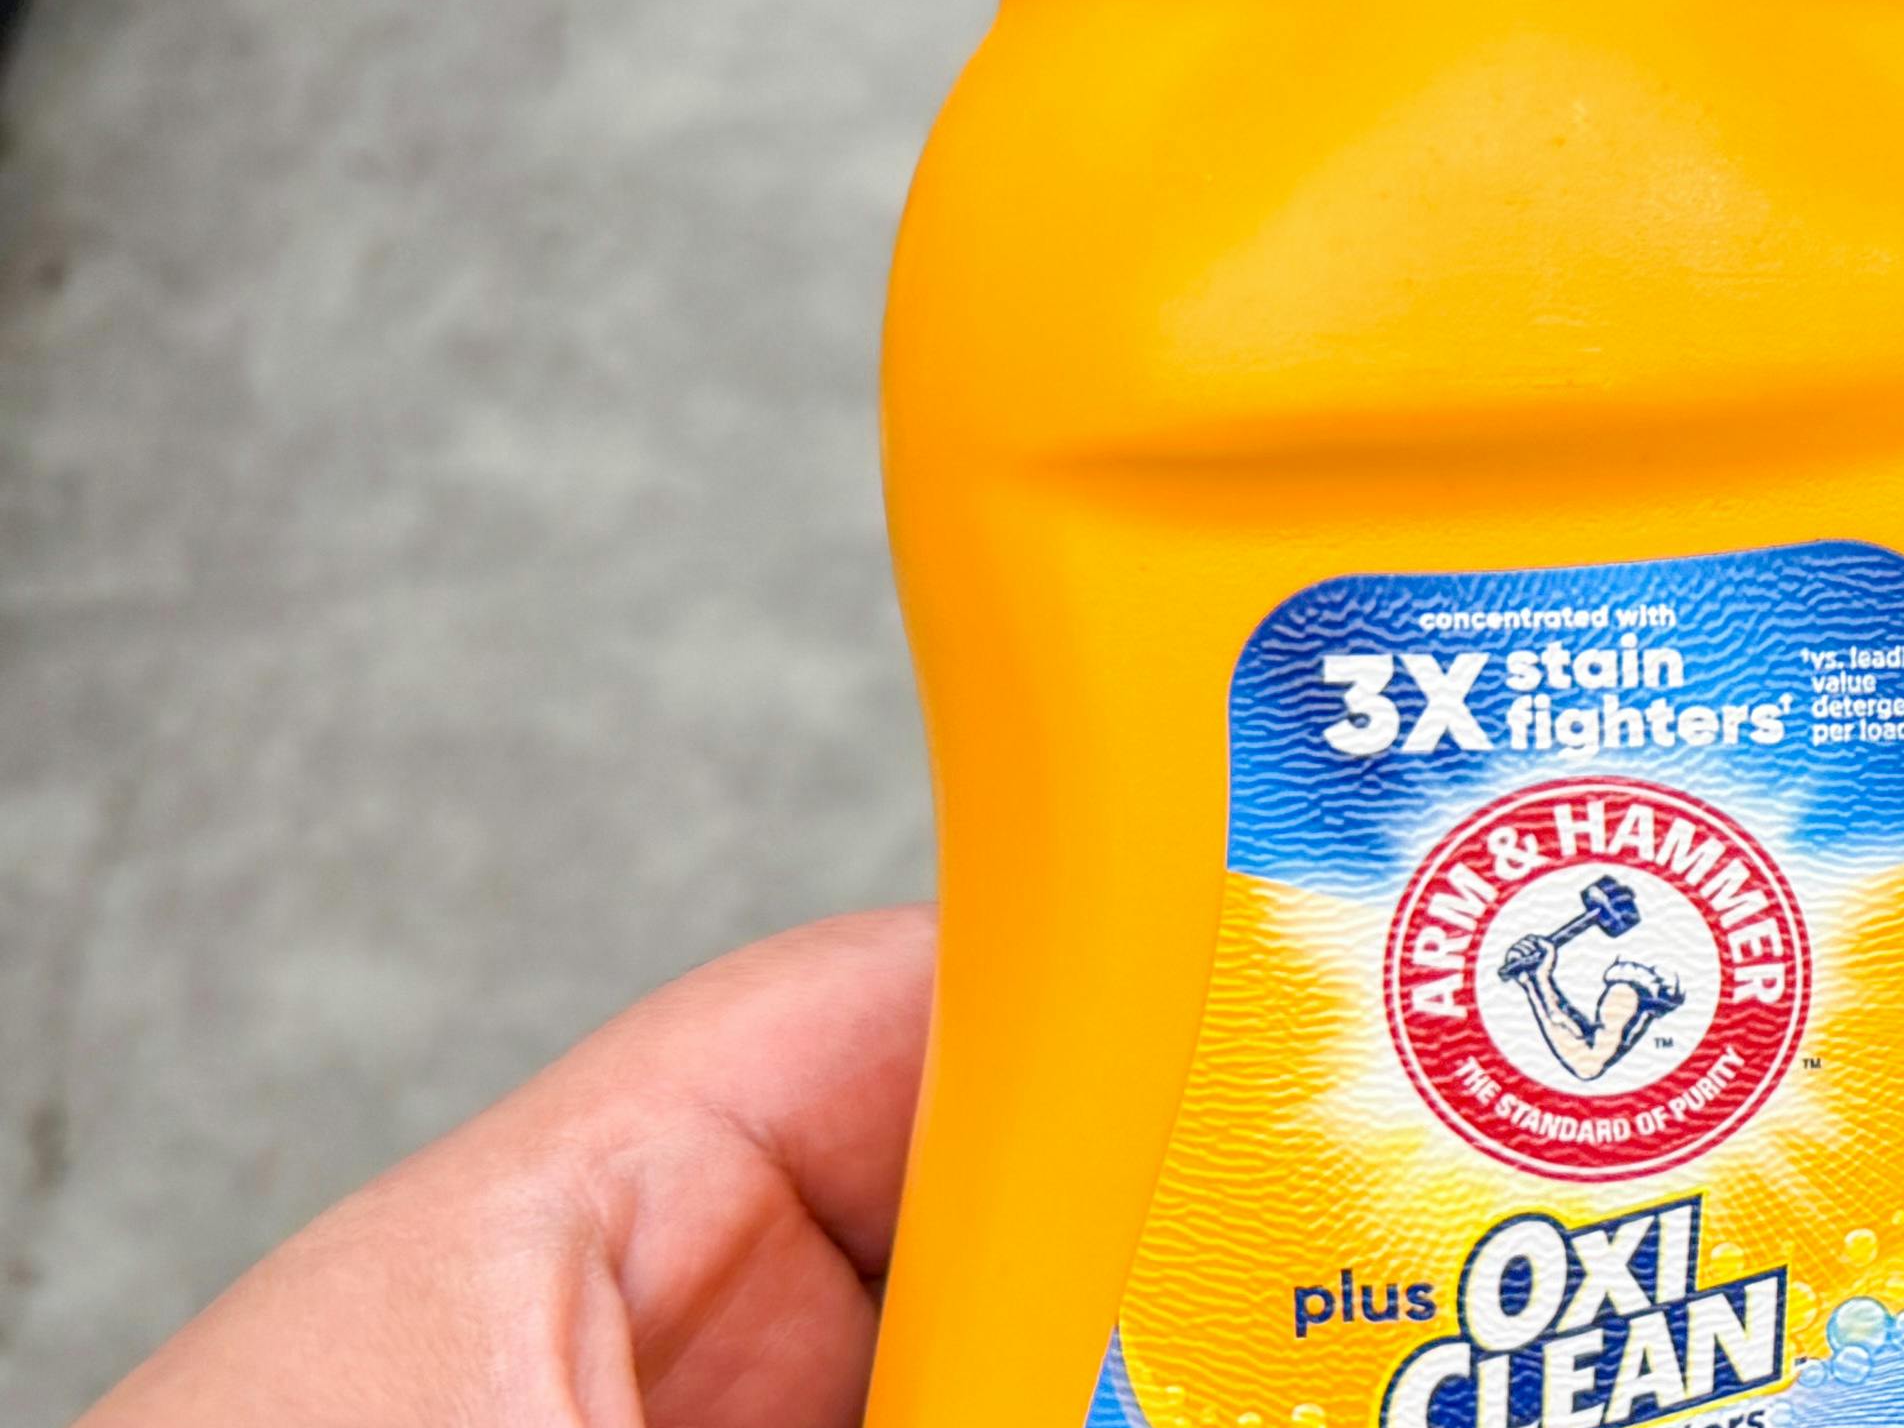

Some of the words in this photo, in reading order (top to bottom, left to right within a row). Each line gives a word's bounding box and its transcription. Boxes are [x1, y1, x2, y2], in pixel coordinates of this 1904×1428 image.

[1419, 606, 1609, 632] concentrated
[1617, 604, 1676, 628] with
[1322, 653, 1494, 757] 3X
[1506, 633, 1685, 691] stain
[1812, 671, 1876, 693] value
[1812, 723, 1855, 746] per
[1407, 872, 1497, 1019] ARM
[1487, 825, 1547, 877] &
[1553, 800, 1786, 1006] HAMMER
[1451, 1054, 1501, 1108] THE
[1494, 1091, 1631, 1144] STANDARD
[1637, 1106, 1668, 1135] OF
[1670, 1048, 1745, 1121] PURITY
[1293, 1269, 1437, 1339] plus
[1466, 1199, 1700, 1344] OXI
